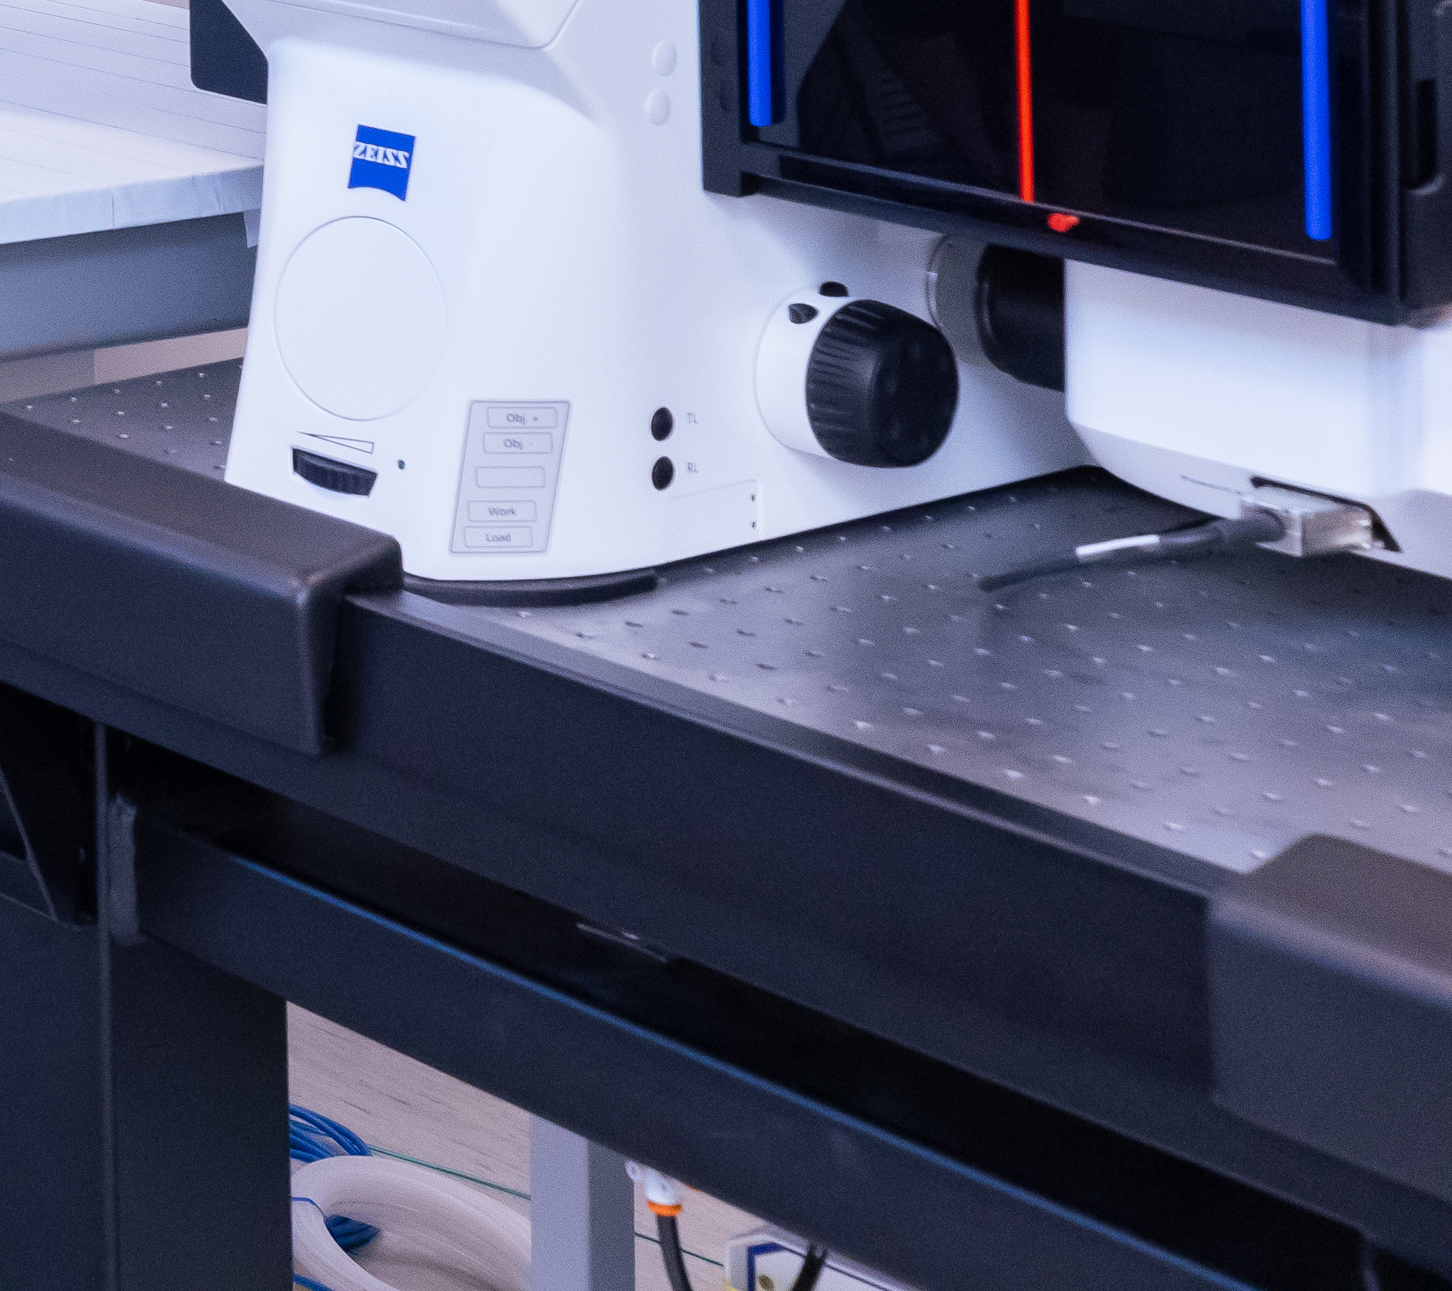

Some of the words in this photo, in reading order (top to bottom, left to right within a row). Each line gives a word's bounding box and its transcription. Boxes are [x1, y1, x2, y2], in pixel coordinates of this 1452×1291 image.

[353, 140, 410, 170] ZEISS
[506, 413, 526, 425] Obj
[488, 507, 517, 517] Work
